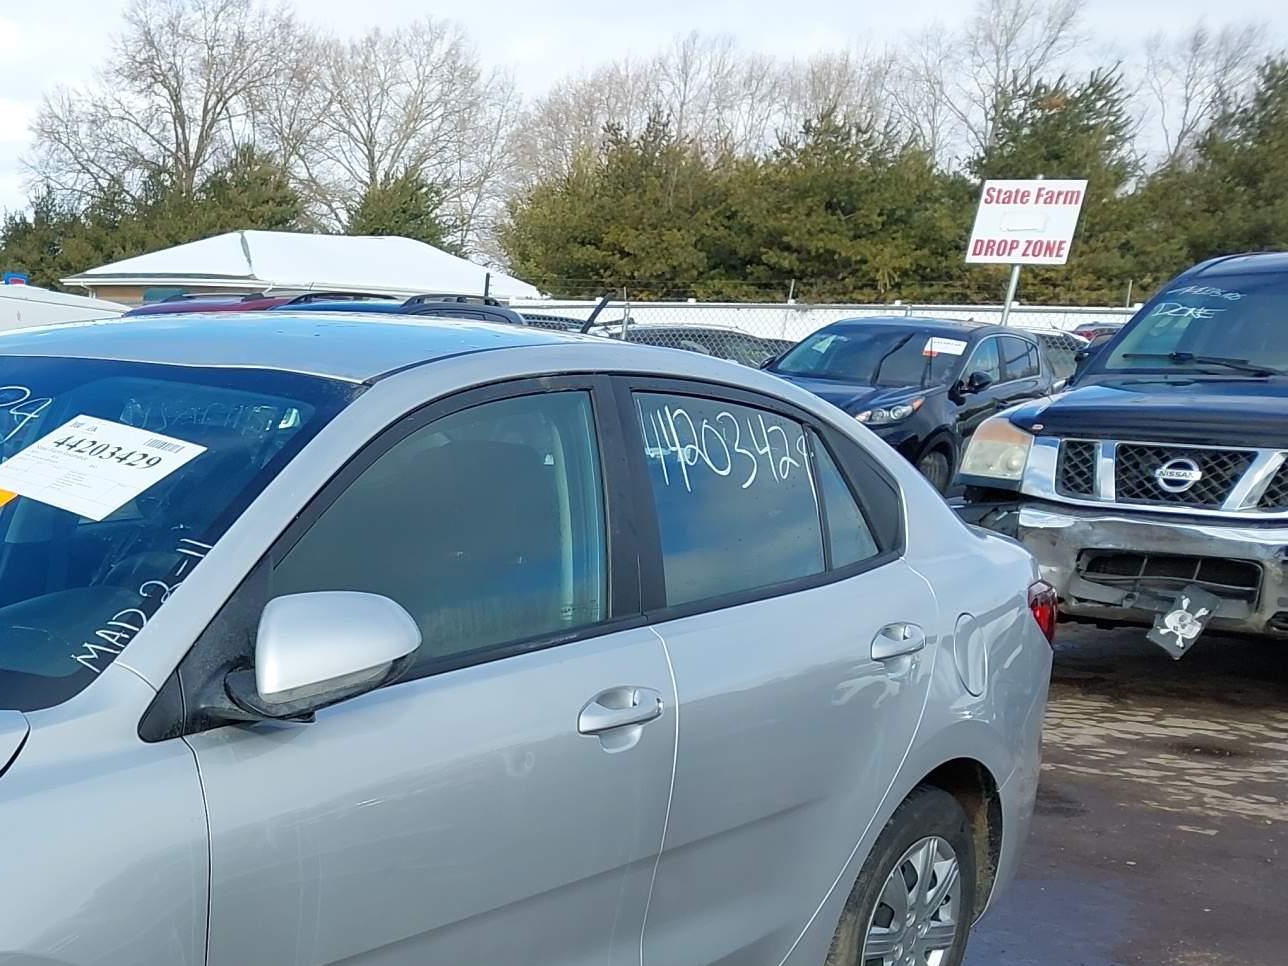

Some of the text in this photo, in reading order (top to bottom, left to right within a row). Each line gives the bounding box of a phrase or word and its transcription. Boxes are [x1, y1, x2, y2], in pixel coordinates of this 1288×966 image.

[983, 186, 1081, 205] State Farm
[972, 238, 1066, 258] DROP ZONE
[53, 435, 162, 470] 44203429
[636, 398, 820, 516] 44203429
[1158, 470, 1195, 479] NISSAN
[70, 538, 214, 674] MAD 2-11
